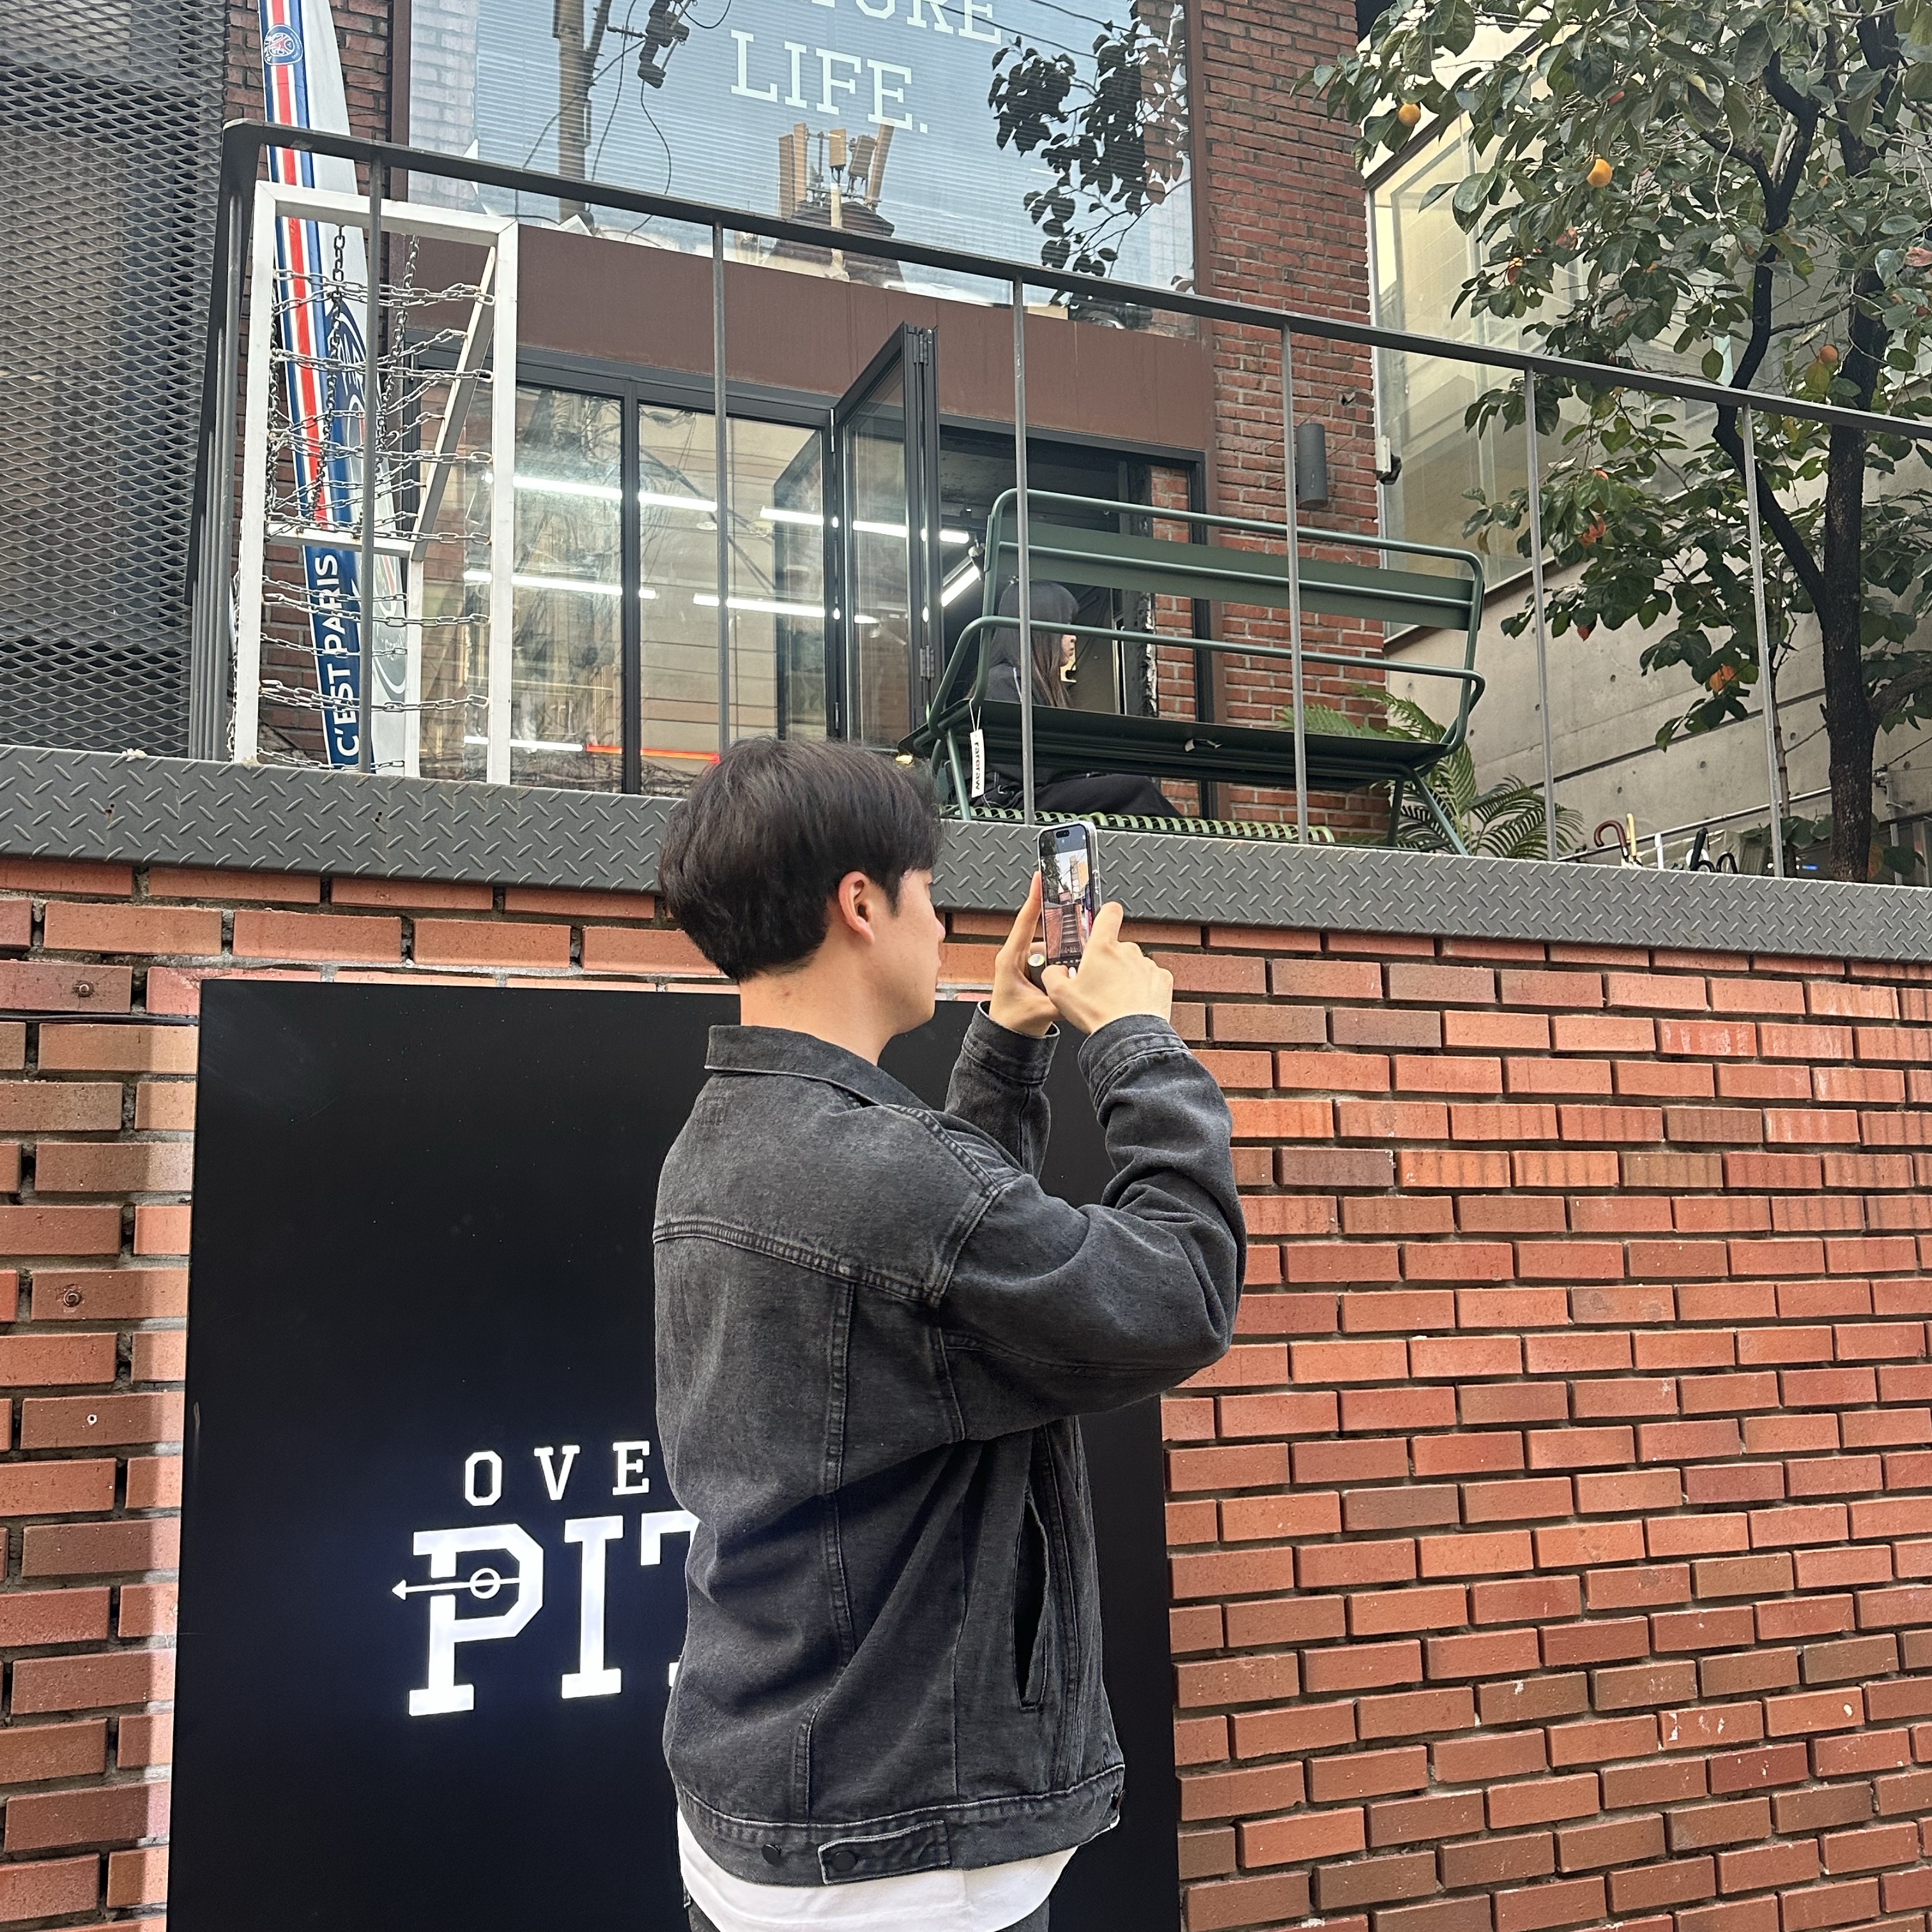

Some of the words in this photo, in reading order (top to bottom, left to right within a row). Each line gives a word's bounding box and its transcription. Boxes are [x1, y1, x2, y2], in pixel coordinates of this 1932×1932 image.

[731, 29, 928, 134] LIFE.
[315, 554, 349, 658] PARIS
[327, 663, 360, 756] C'EST
